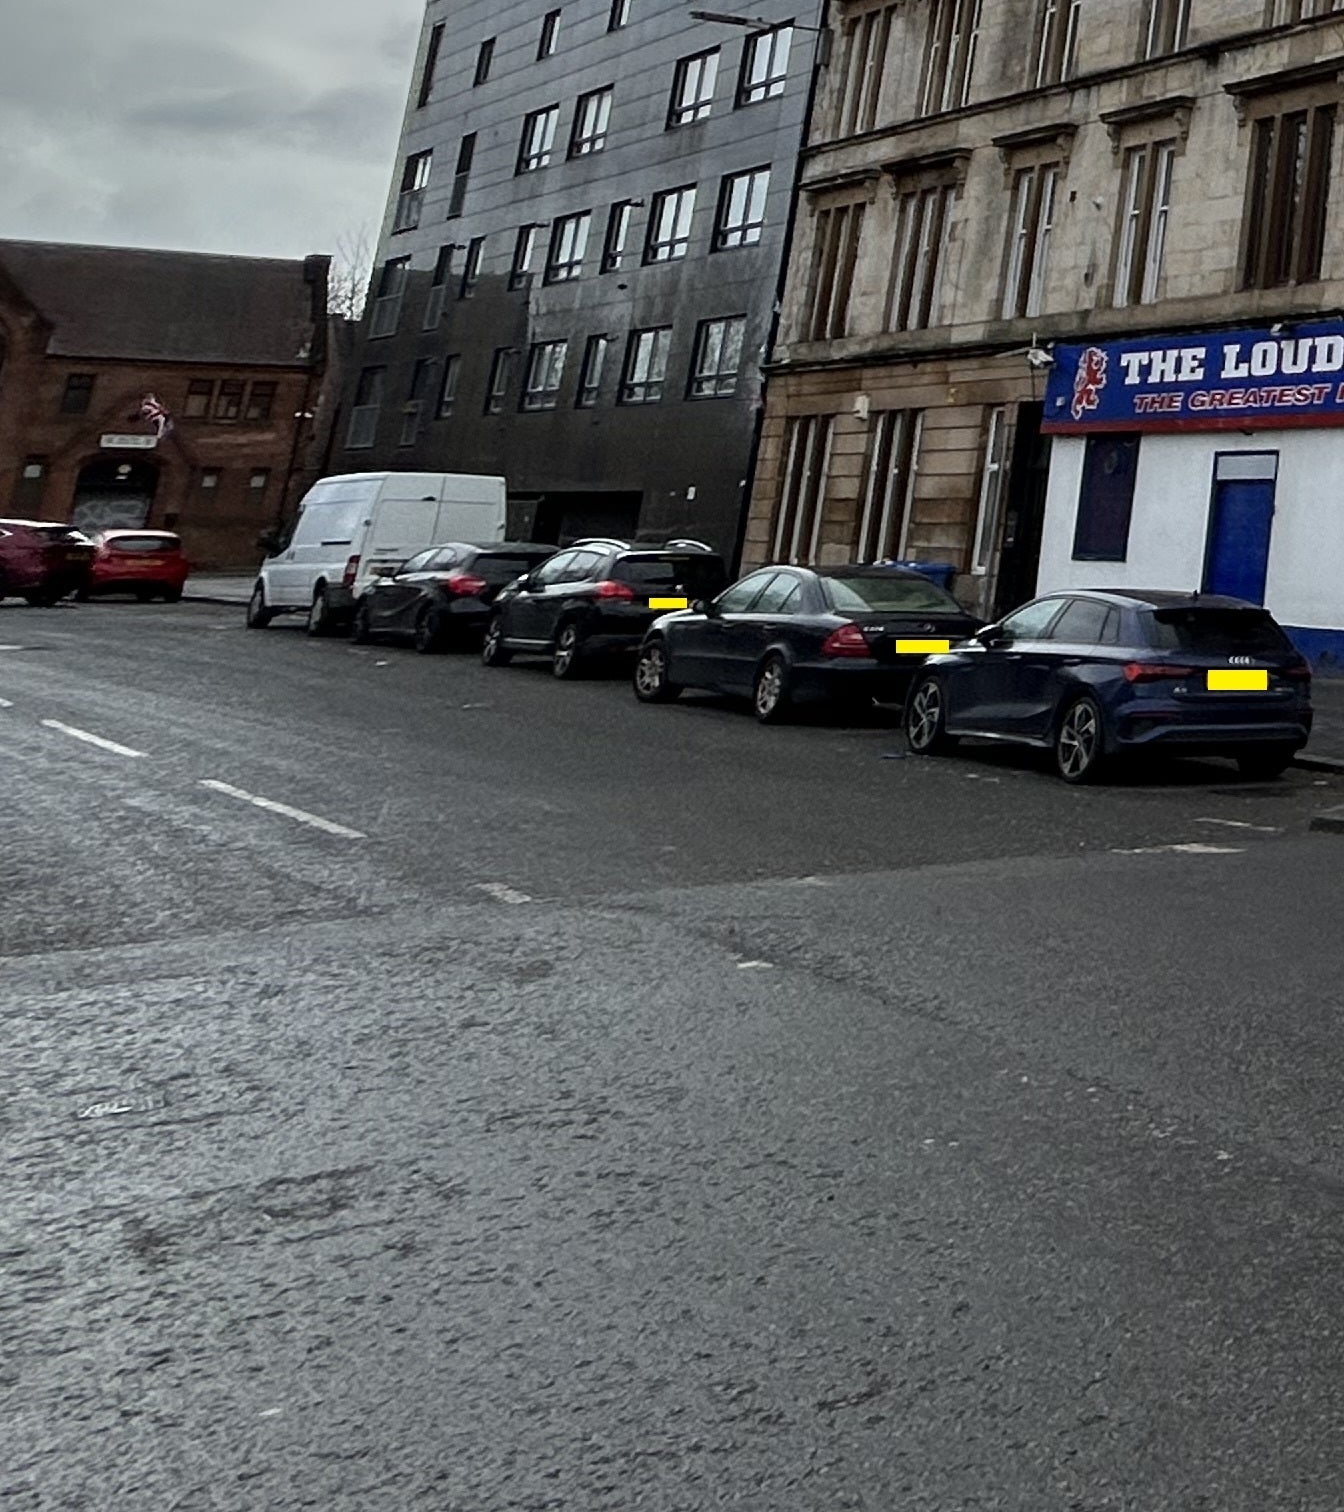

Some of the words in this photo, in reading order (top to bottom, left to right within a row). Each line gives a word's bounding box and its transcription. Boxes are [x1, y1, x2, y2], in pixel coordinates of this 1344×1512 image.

[1120, 347, 1206, 385] THE
[1133, 392, 1183, 414] THE
[1188, 384, 1330, 411] GREATEST
